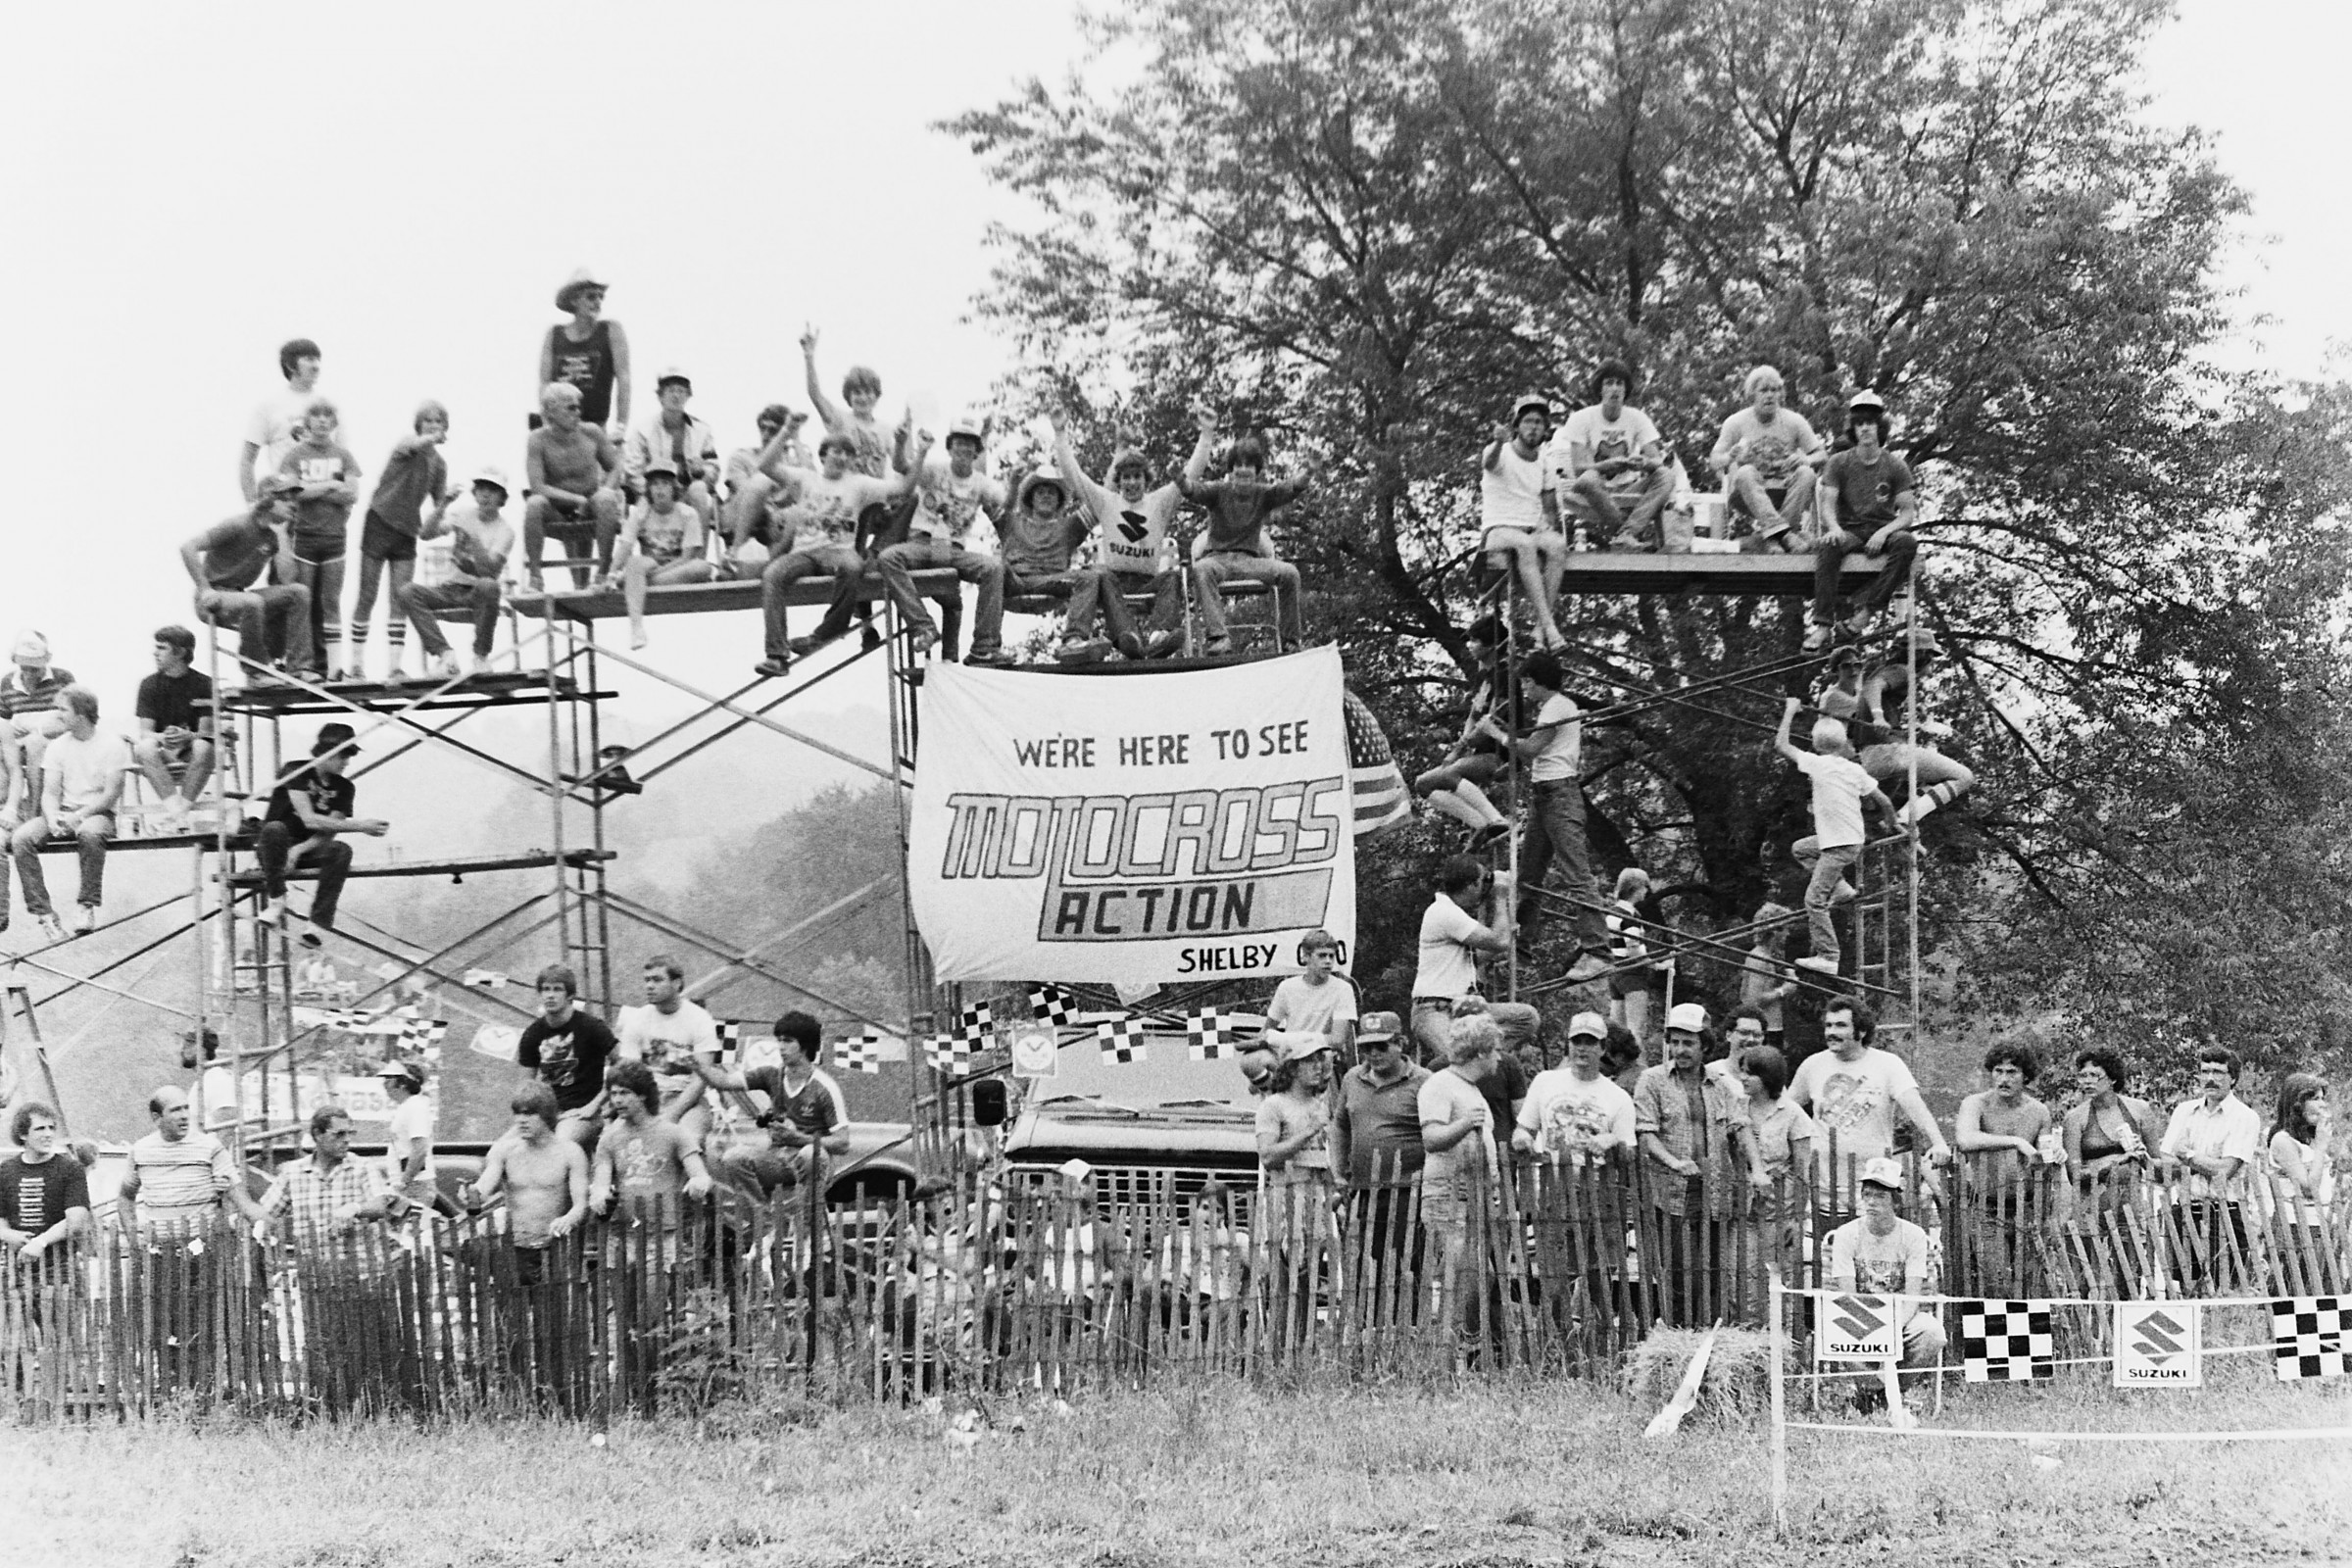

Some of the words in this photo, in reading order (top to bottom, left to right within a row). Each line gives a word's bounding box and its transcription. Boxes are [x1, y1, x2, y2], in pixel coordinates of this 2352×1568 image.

[1109, 542, 1154, 559] SUZUKI
[1012, 731, 1095, 768] WE'RE
[1119, 734, 1190, 766] HERE
[1210, 728, 1250, 760] TO
[1258, 719, 1309, 757] SEE
[941, 775, 1344, 880] MOTOCROSS
[1054, 882, 1255, 934] ACTION
[1177, 944, 1277, 973] SHELBY
[1297, 940, 1347, 966] OO
[1830, 1343, 1888, 1353] SUZUKI
[2129, 1368, 2186, 1379] SUZUKI
